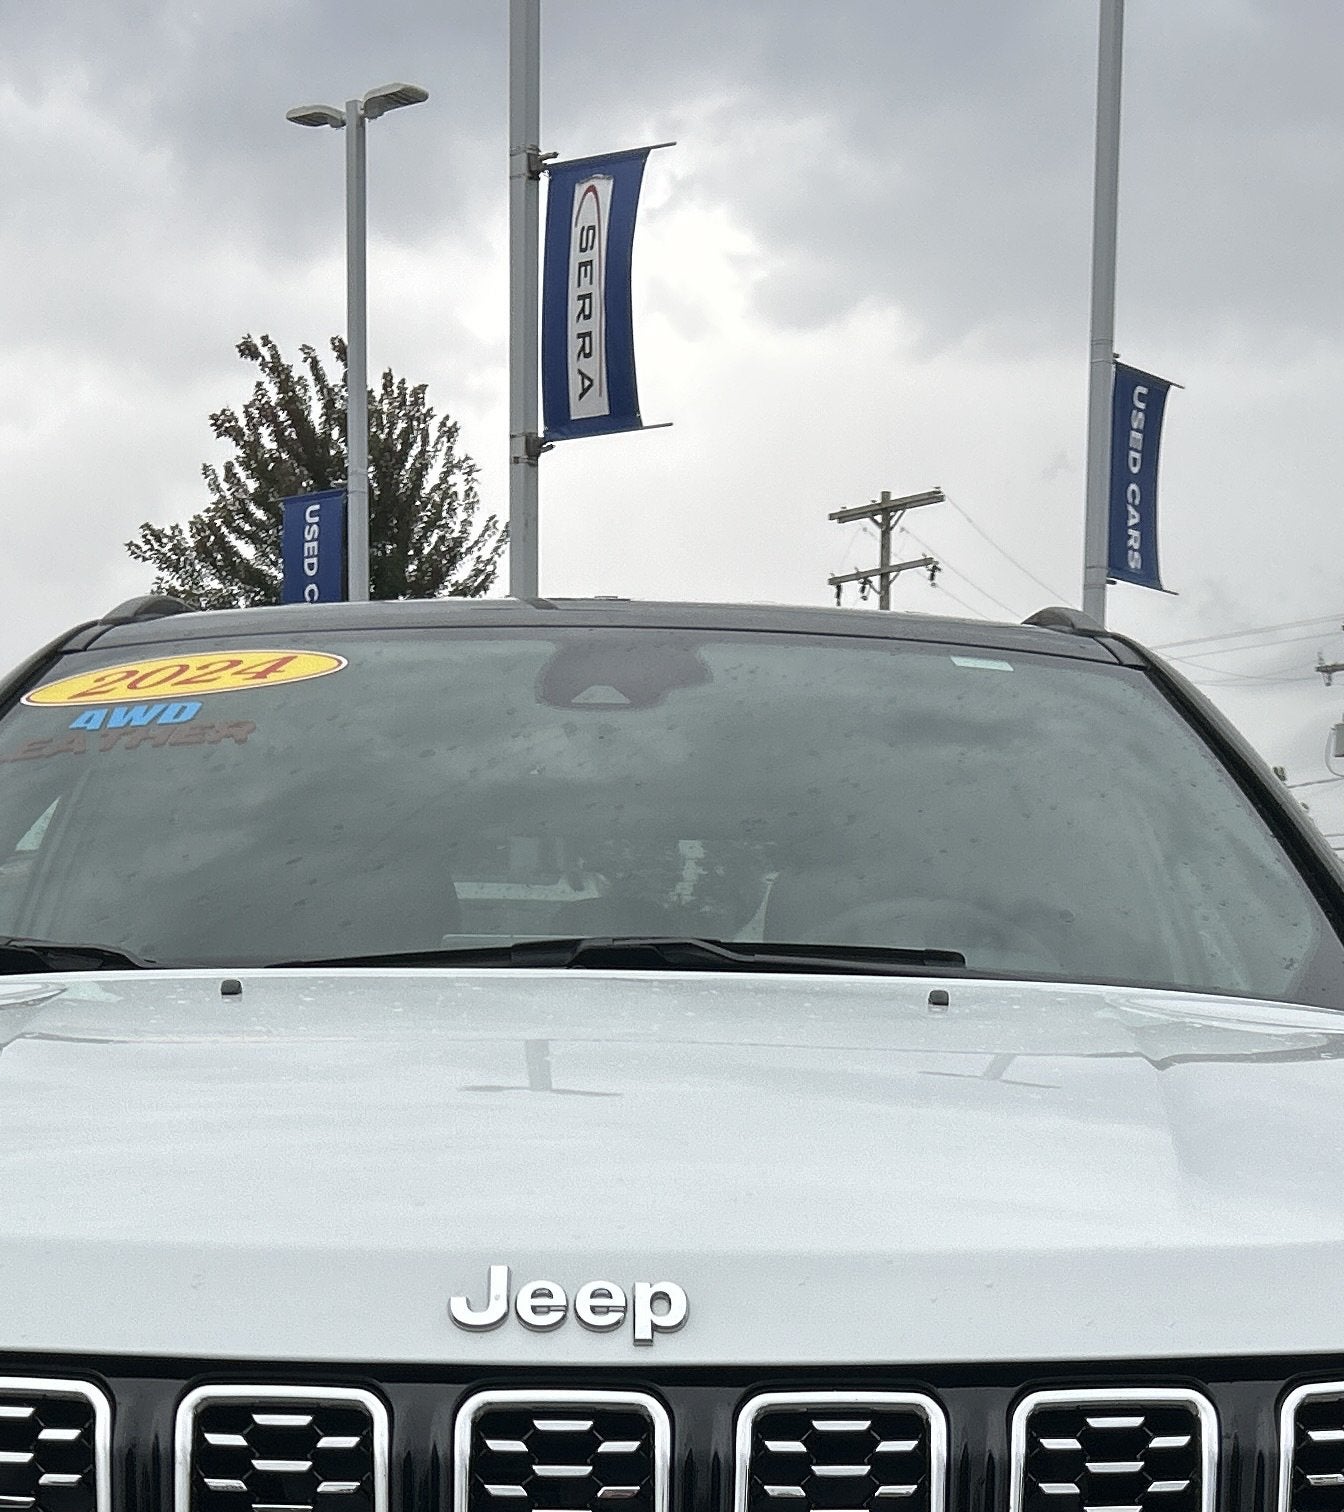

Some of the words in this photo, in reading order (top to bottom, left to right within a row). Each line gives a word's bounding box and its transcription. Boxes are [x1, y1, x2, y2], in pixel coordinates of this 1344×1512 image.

[575, 225, 596, 401] SERRA
[1128, 385, 1149, 475] USED
[303, 504, 321, 576] USED
[1126, 482, 1142, 570] CARS
[67, 655, 298, 700] 2024
[68, 701, 203, 731] 4WD
[448, 1265, 690, 1347] Jeep
